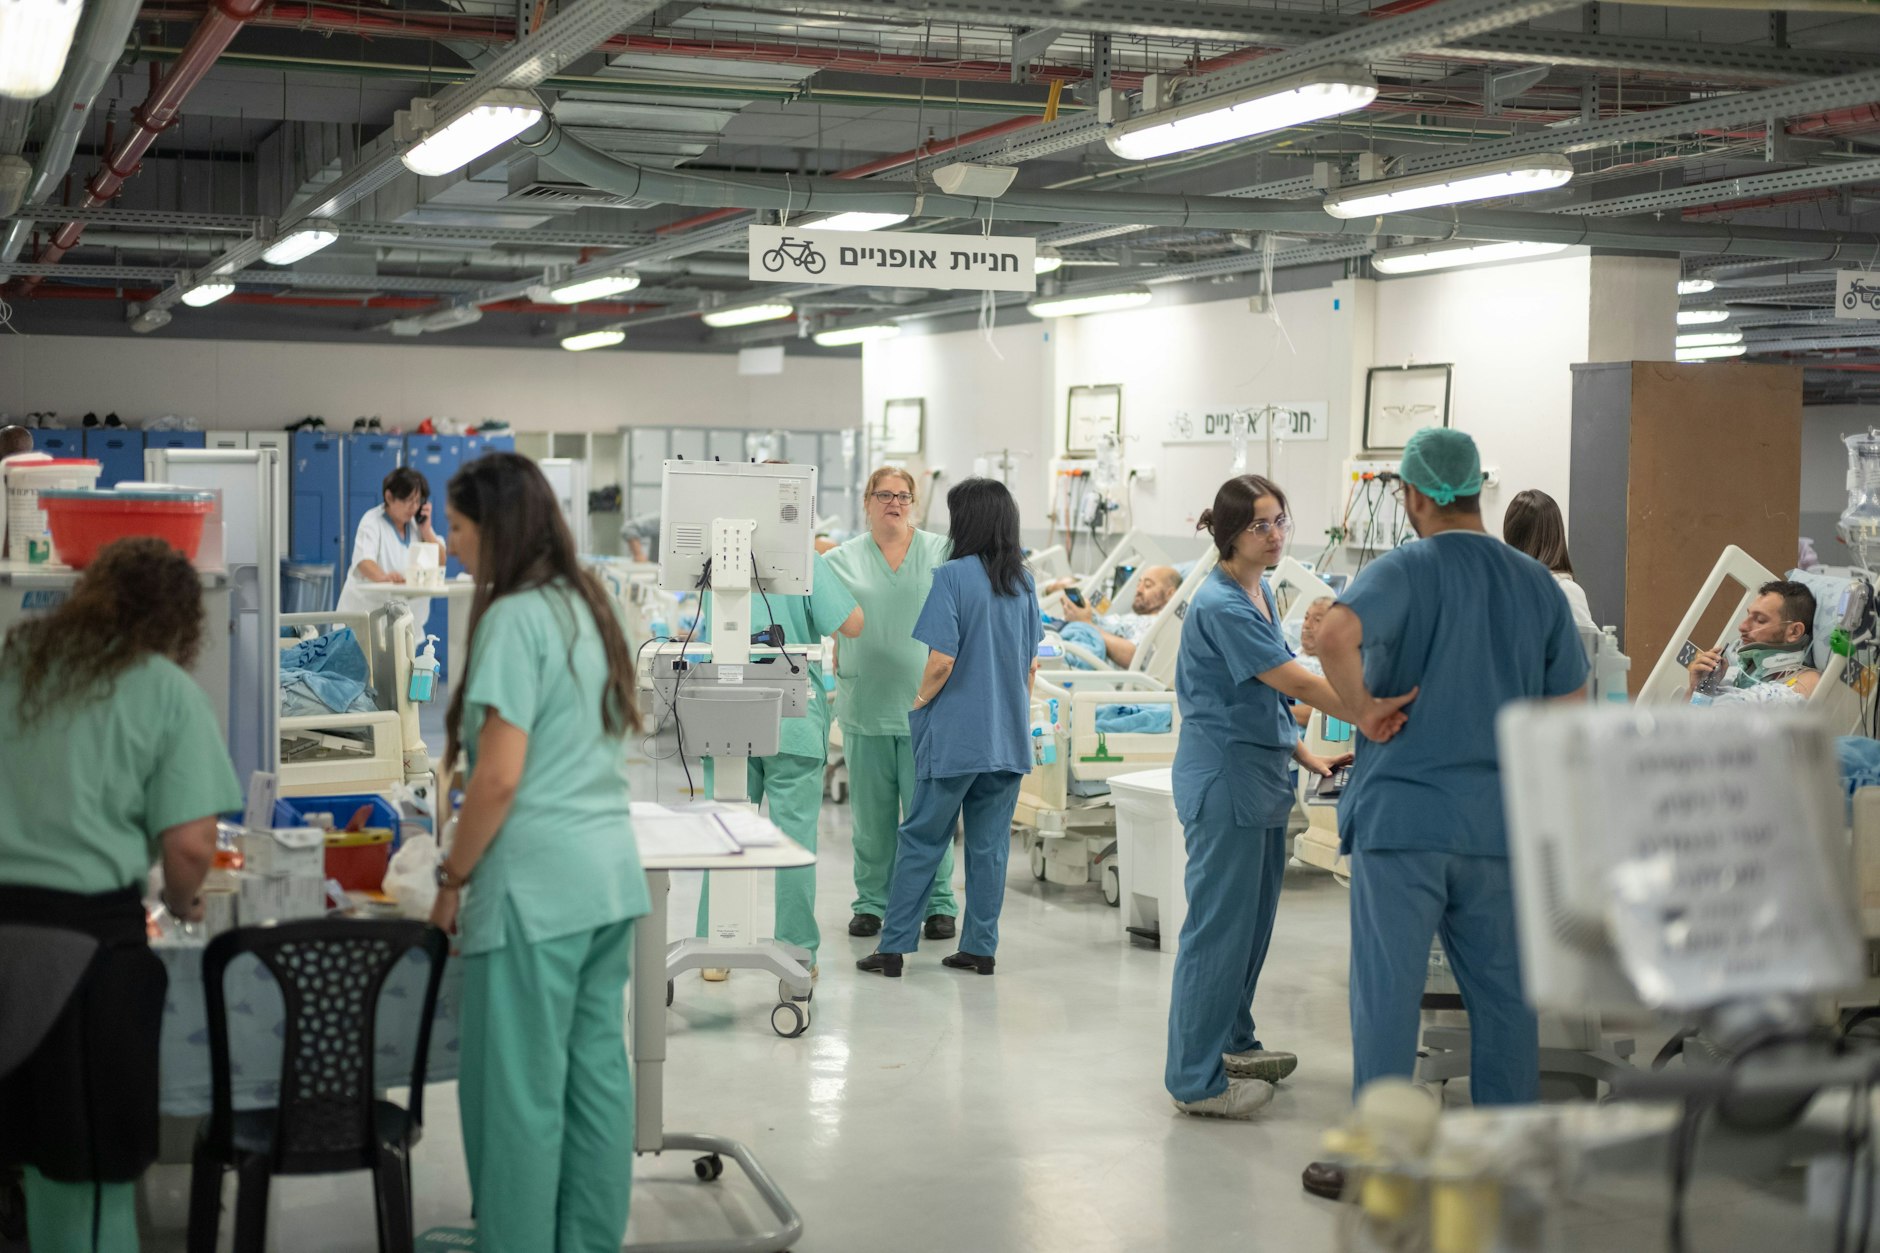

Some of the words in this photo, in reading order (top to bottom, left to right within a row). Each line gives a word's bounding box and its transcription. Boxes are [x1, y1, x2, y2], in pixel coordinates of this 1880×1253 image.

[839, 246, 937, 270] אופניים
[950, 250, 1019, 273] חניית
[1205, 413, 1257, 434] אניים
[1272, 411, 1311, 433] חני
